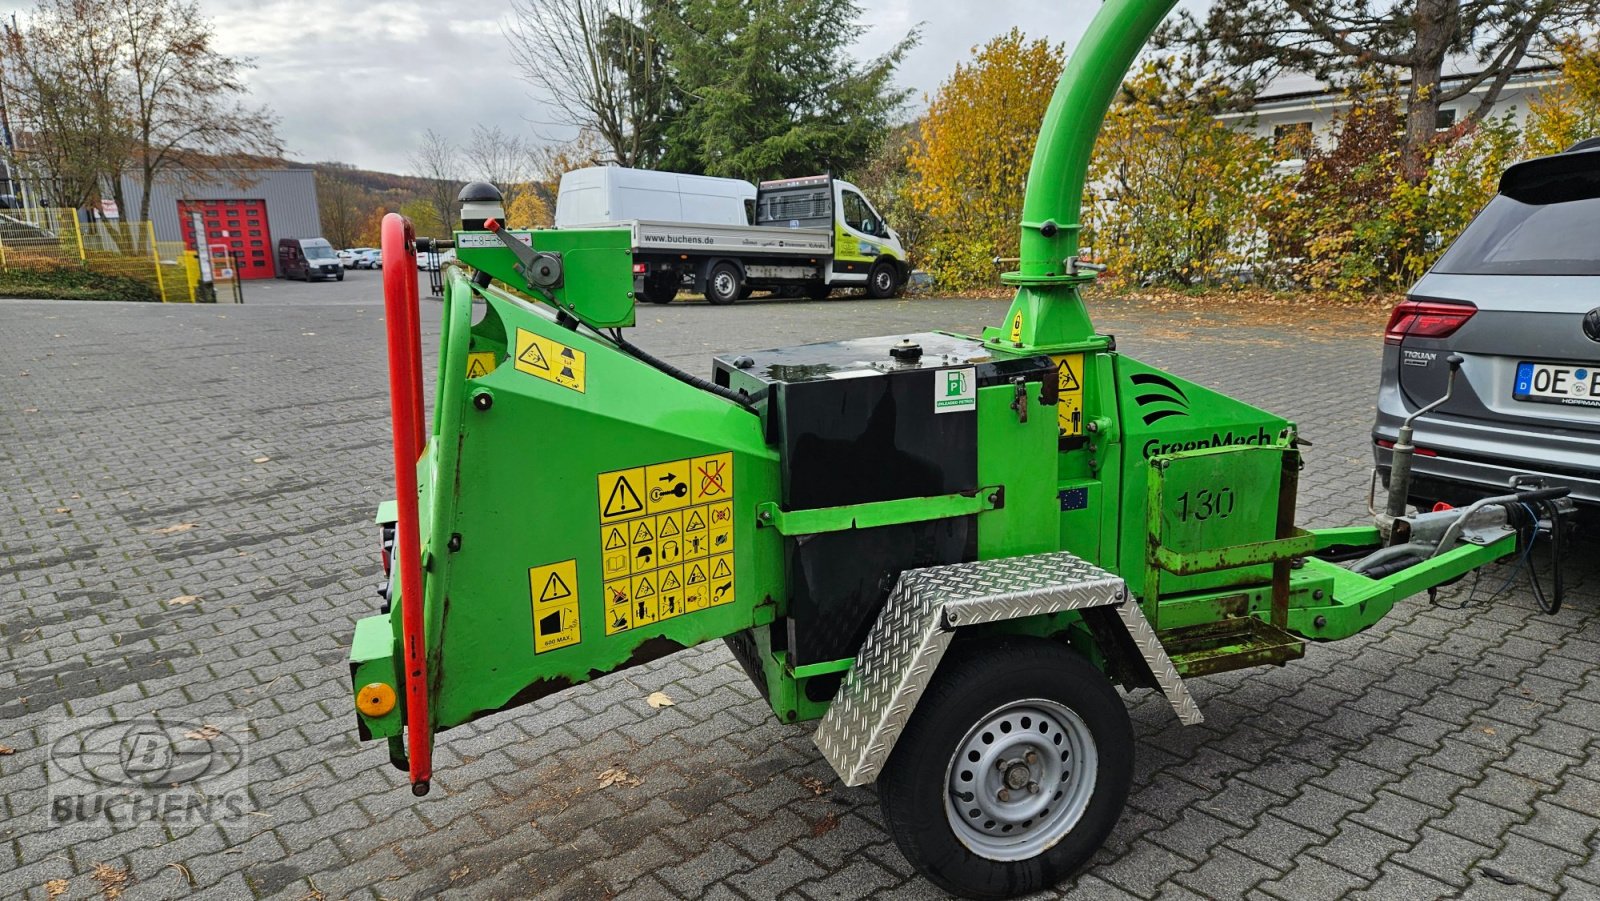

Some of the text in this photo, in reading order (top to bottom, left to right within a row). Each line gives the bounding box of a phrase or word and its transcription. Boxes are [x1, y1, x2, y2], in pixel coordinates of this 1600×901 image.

[645, 235, 714, 244] www.buchens.de
[1403, 350, 1437, 360] TIGUAN
[1520, 382, 1527, 390] D
[1534, 369, 1570, 394] OE
[1143, 426, 1271, 460] GreenMech
[1177, 487, 1235, 522] 130
[557, 635, 571, 643] MAX
